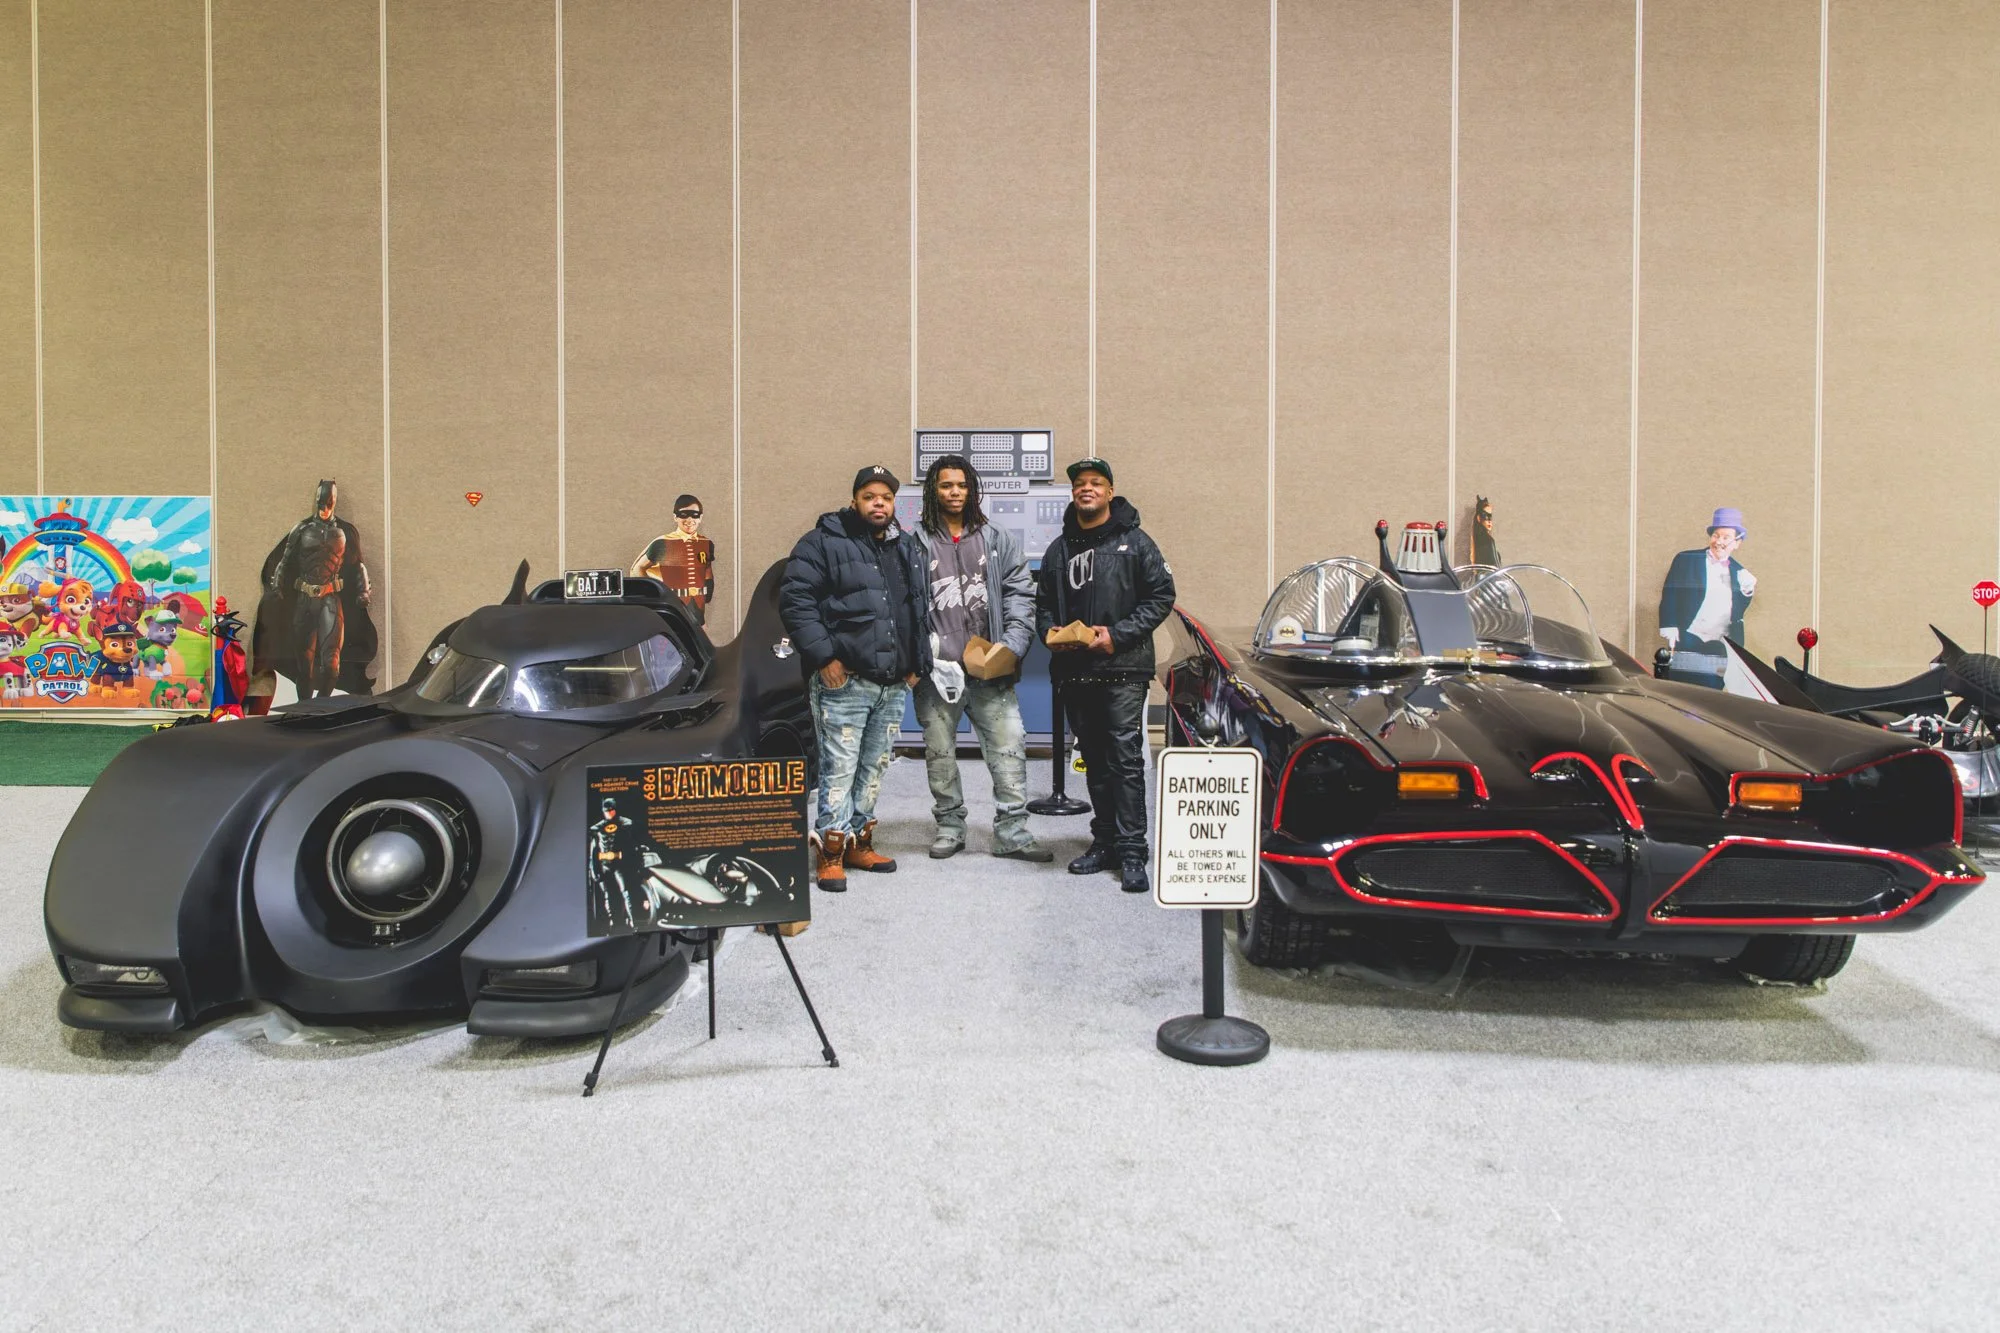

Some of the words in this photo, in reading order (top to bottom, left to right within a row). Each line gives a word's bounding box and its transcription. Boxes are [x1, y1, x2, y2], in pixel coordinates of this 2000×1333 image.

[979, 481, 1022, 490] MPUTER
[699, 551, 707, 564] R
[578, 576, 599, 592] BAT
[604, 576, 610, 591] 1
[1973, 587, 2000, 599] STOP
[24, 651, 101, 679] PAW
[42, 682, 83, 691] PATROL
[643, 768, 656, 801] 1989
[658, 761, 805, 801] BATMOBILE
[1168, 777, 1249, 794] BATMOBILE
[1177, 800, 1240, 817] PARKING
[1189, 823, 1227, 839] ONLY
[1167, 850, 1185, 859] ALL
[1188, 850, 1223, 859] OTHERS
[1226, 850, 1247, 859] WILL
[1177, 862, 1189, 871] BE
[1193, 862, 1222, 871] TOWED
[1226, 862, 1236, 871] AT
[1166, 875, 1204, 883] JOKER'S
[1207, 875, 1247, 883] EXPENSE
